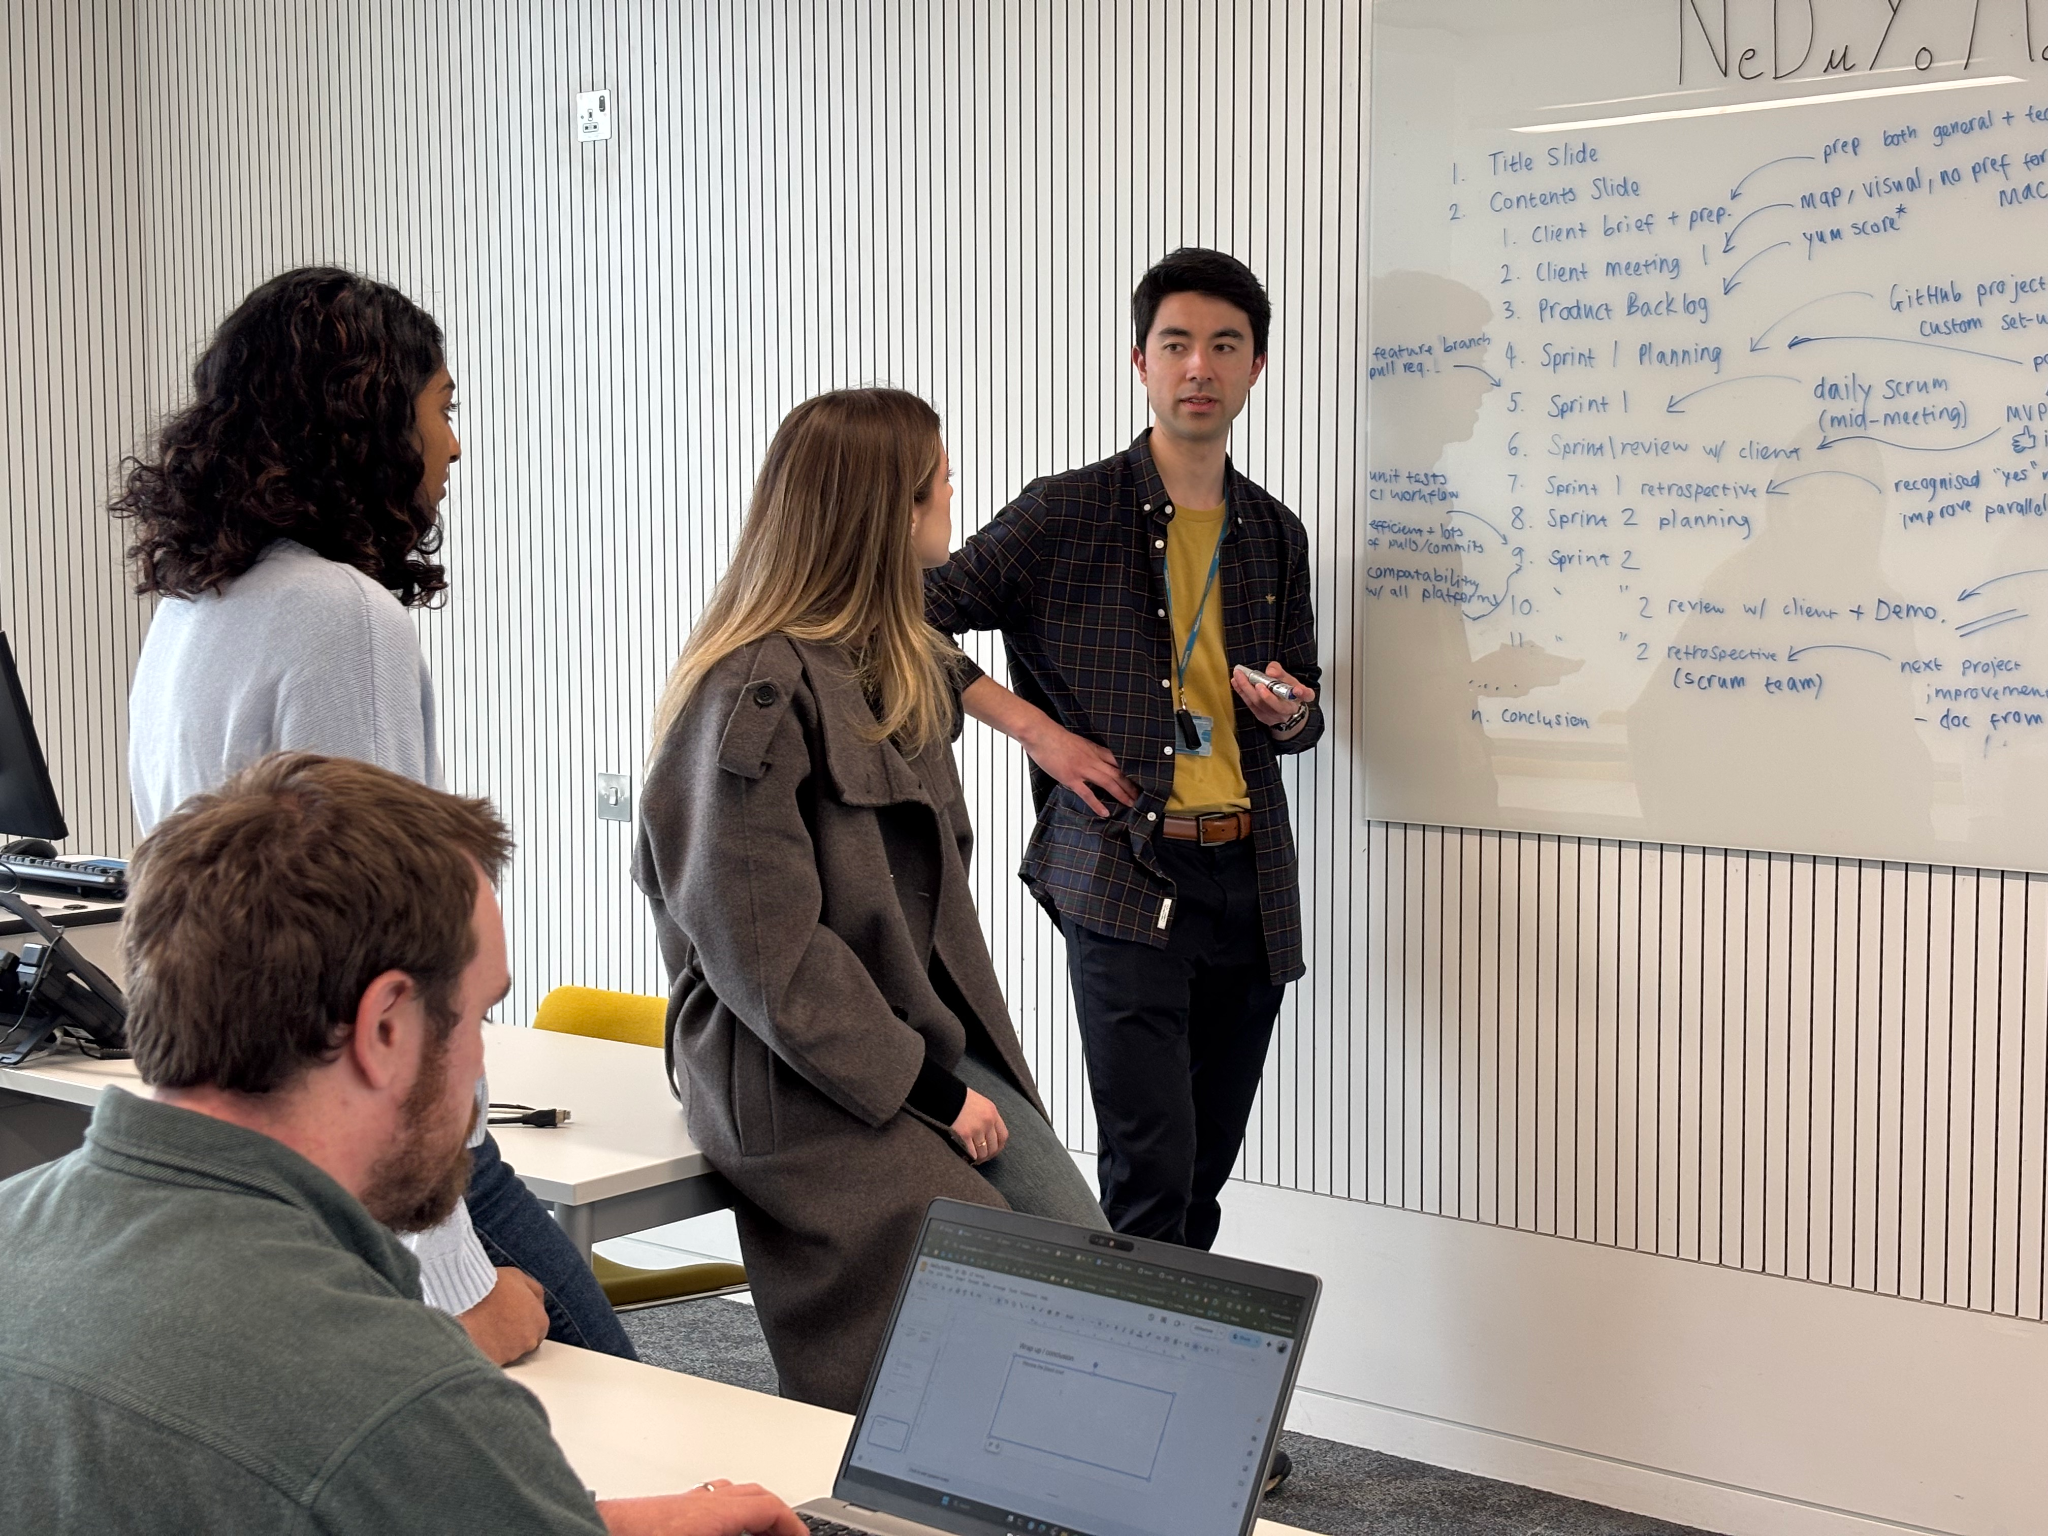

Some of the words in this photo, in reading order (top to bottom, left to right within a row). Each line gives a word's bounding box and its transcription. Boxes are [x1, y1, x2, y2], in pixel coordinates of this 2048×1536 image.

[1822, 134, 1861, 165] prep
[1883, 124, 1918, 148] both
[1932, 109, 1994, 147] general
[1452, 162, 1467, 184] 1.
[1488, 150, 1534, 176] Title
[1547, 142, 1599, 168] Slide
[1940, 167, 1962, 186] no
[1971, 153, 2012, 184] pref
[1449, 203, 1466, 221] 2.
[1490, 186, 1578, 213] Contents
[1591, 176, 1641, 201] Slide
[1502, 228, 1517, 248] 1.
[1532, 221, 1588, 244] Client
[1603, 213, 1655, 237] brief
[1689, 205, 1733, 232] prep.
[1802, 228, 1844, 261] yum
[1500, 263, 1521, 285] 2.
[1536, 260, 1590, 283] Client
[1606, 253, 1682, 280] meeting
[1502, 300, 1521, 320] 3.
[1538, 296, 1614, 324] Product
[1625, 291, 1709, 325] Backlog
[1890, 279, 1963, 313] GitHub
[1976, 273, 2048, 307] project
[1372, 343, 1433, 362] feature
[1442, 332, 1492, 353] branch
[1504, 340, 1525, 370] 4.
[1540, 342, 1597, 375] Sprint
[1638, 342, 1723, 375] Planning
[1368, 360, 1396, 380] pull
[1402, 360, 1431, 379] req.
[1506, 391, 1525, 412] 5.
[1547, 393, 1610, 419] Sprint
[1813, 372, 1873, 414] daily
[1818, 400, 1968, 433] (mid-meeting)
[2005, 401, 2048, 424] MVP
[1507, 431, 1528, 457] 6.
[1369, 468, 1401, 485] unit
[1406, 472, 1447, 486] tests
[1507, 474, 1524, 493] 7.
[1545, 475, 1598, 497] Sprint
[1640, 480, 1758, 503] retrospective
[1893, 470, 1981, 503] recognised
[1390, 487, 1459, 505] workflow
[1369, 519, 1424, 537] efficient
[1440, 522, 1464, 540] lots
[1511, 506, 1533, 530] 8.
[1547, 508, 1608, 533] Sprint
[1621, 508, 1639, 527] 2
[1658, 508, 1751, 540] planning
[1899, 499, 1972, 530] improve
[1367, 536, 1380, 552] of
[1511, 546, 1534, 566] 9.
[1548, 549, 1610, 573] Sprint
[1621, 549, 1641, 571] 2
[1367, 564, 1480, 597] compatability
[1389, 584, 1408, 599] all
[1511, 594, 1541, 616] 10.
[1639, 596, 1654, 619] 2
[1668, 597, 1725, 615] review
[1743, 597, 1767, 621] w/
[1782, 597, 1839, 619] client
[1636, 642, 1650, 661] 2
[1667, 645, 1778, 663] retrospective
[1900, 657, 1943, 674] next
[1961, 656, 2022, 679] project
[1673, 667, 1746, 690] (scrum
[1763, 673, 1824, 700] team)
[1939, 707, 1971, 731] doc
[1989, 710, 2043, 731] from
